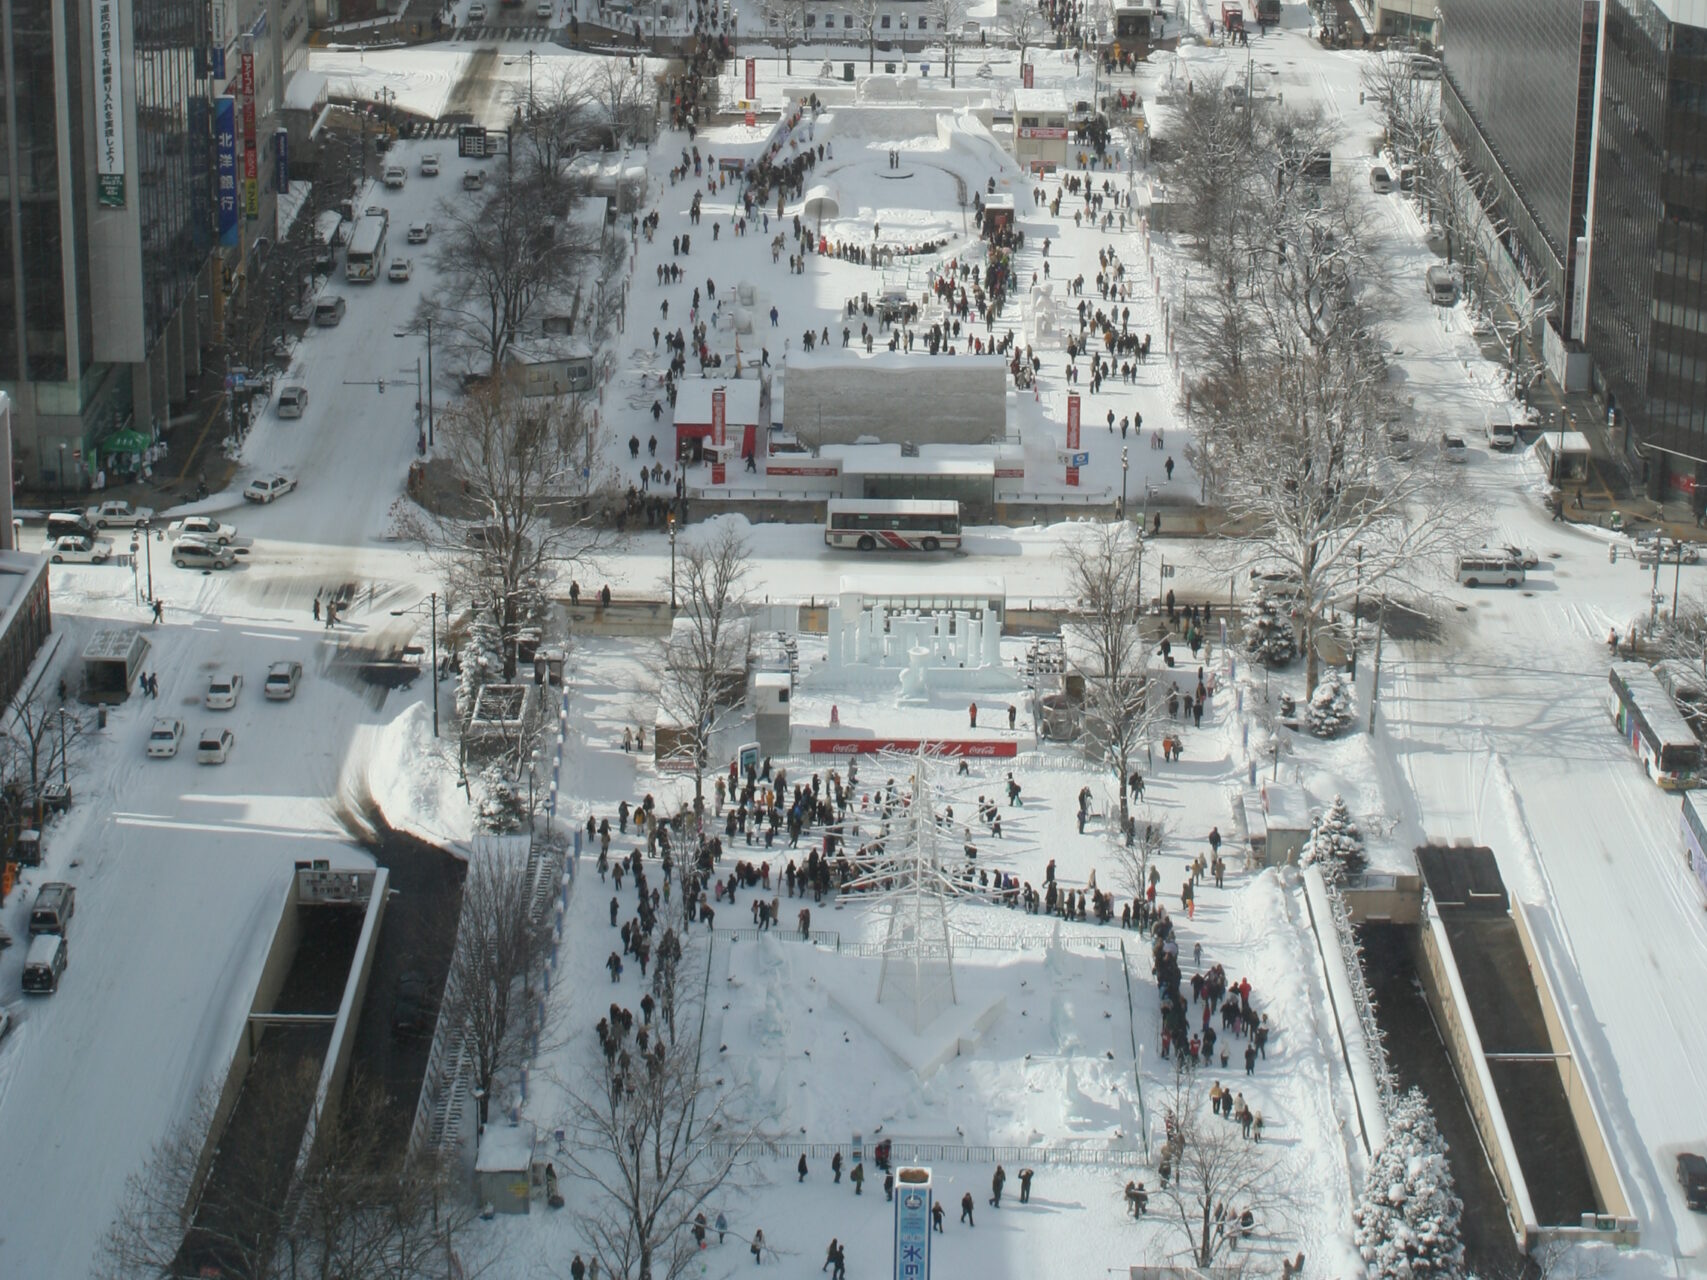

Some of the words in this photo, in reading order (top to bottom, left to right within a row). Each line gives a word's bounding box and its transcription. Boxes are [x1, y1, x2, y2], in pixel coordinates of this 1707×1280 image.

[219, 133, 234, 210] 北洋銀行
[832, 743, 858, 753] Coca-Cola
[969, 745, 994, 755] Coca-Cola
